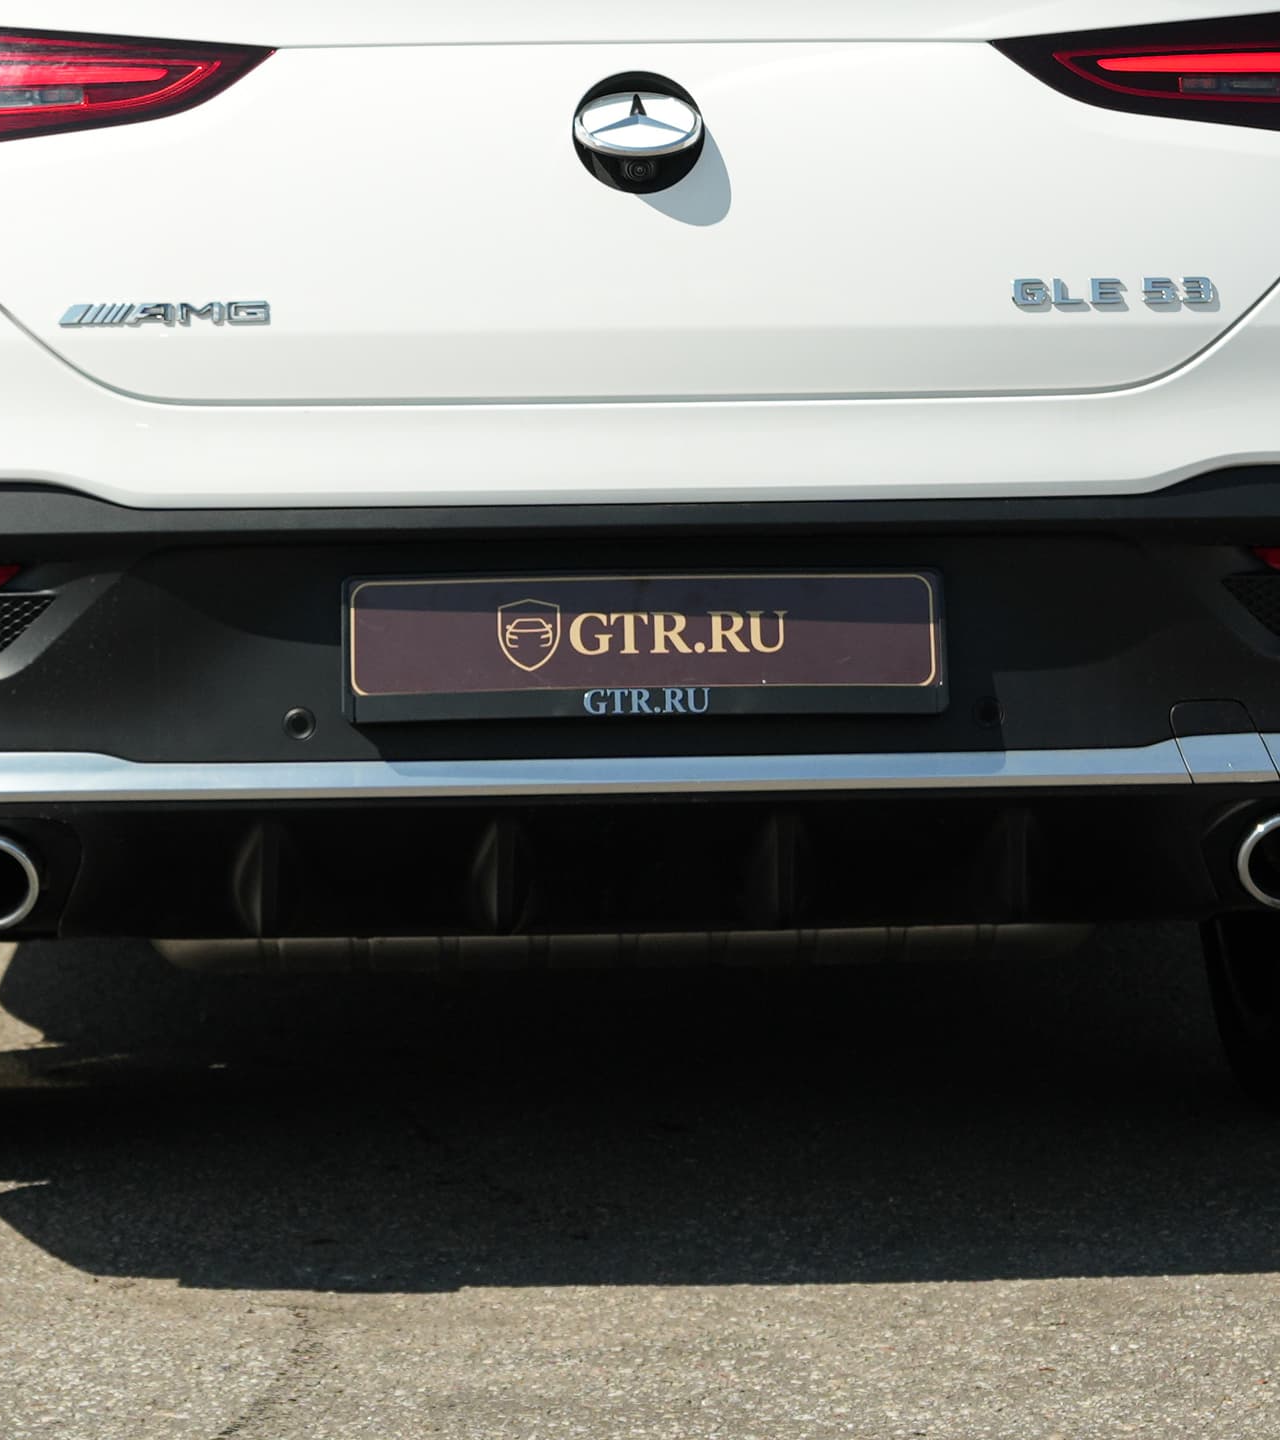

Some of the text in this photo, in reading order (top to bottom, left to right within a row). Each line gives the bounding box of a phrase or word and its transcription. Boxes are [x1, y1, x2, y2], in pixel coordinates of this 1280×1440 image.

[1011, 276, 1213, 305] GLE 53
[126, 300, 271, 327] AMG
[569, 611, 788, 656] GTR.RU
[583, 687, 711, 715] GTR.RU
